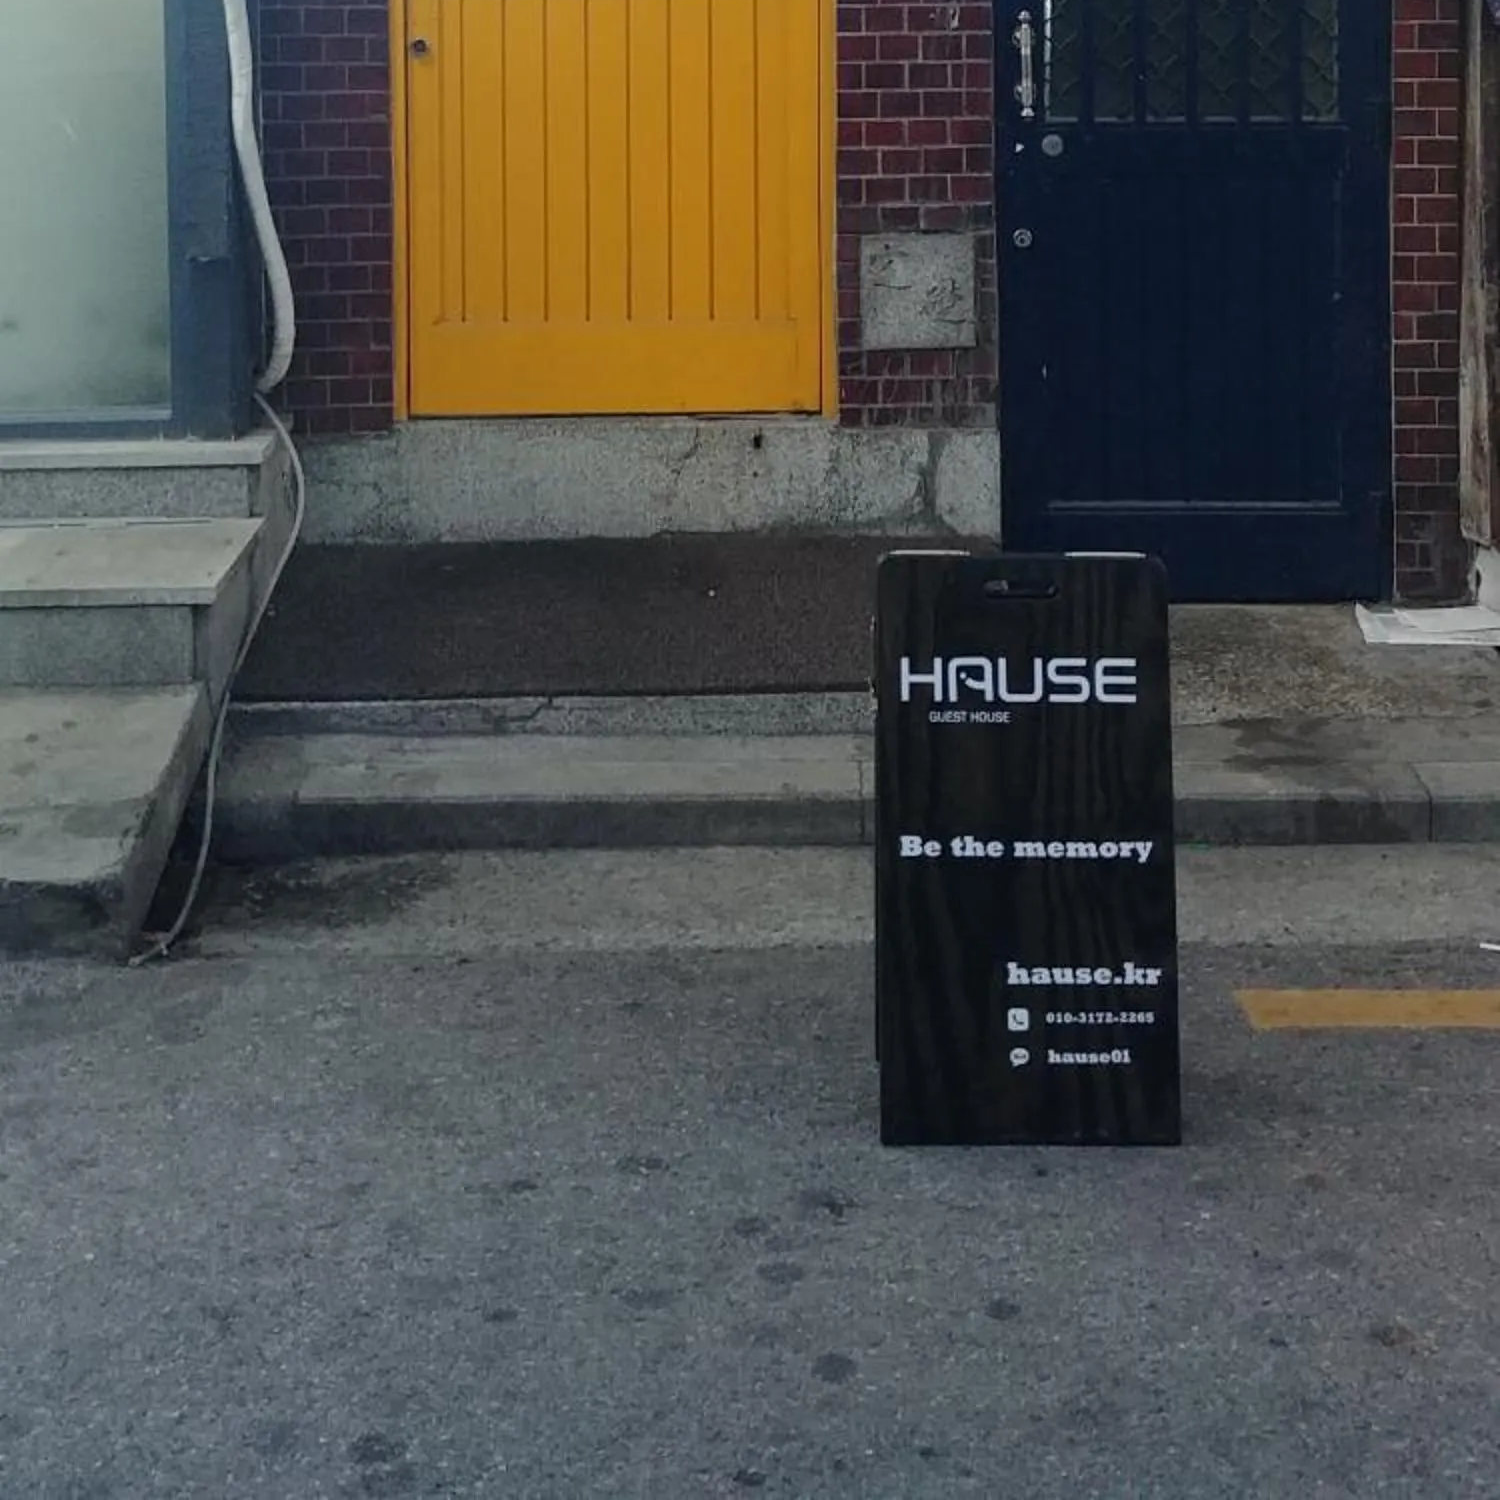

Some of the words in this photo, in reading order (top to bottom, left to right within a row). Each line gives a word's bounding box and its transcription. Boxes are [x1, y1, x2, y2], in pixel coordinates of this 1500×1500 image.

[900, 656, 1137, 703] HAUSE
[929, 711, 967, 723] GUEST
[970, 711, 1012, 723] HOUSE
[900, 835, 942, 857] Be
[950, 835, 1005, 857] the
[1013, 840, 1153, 863] memory
[1006, 961, 1162, 985] hause.kr
[1047, 1048, 1132, 1065] hause01
